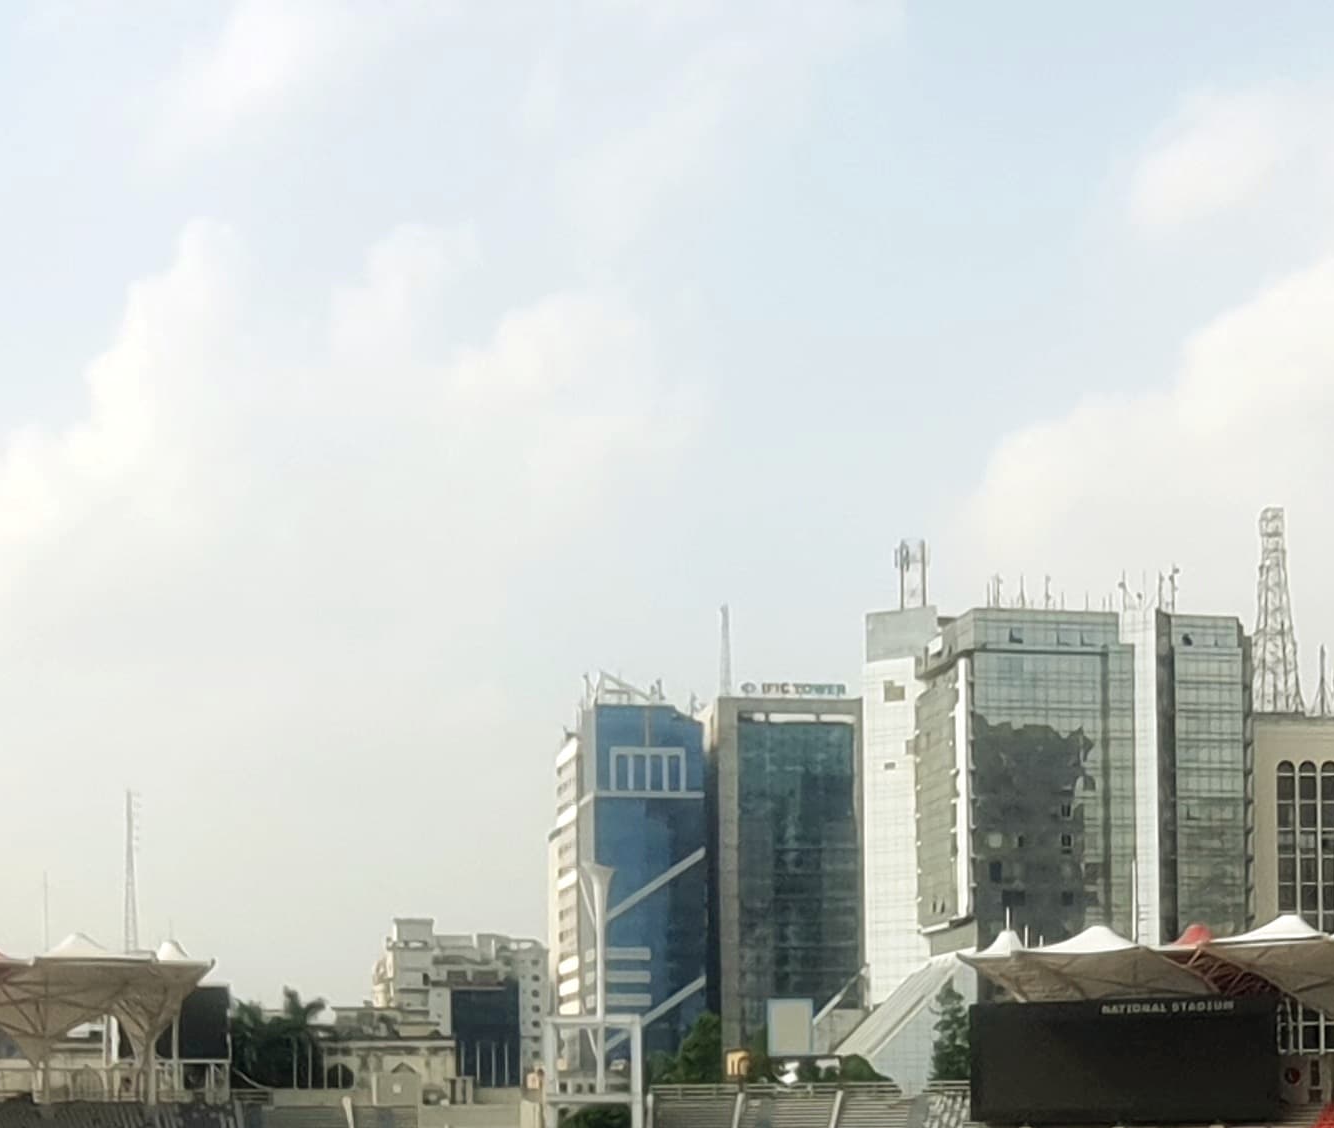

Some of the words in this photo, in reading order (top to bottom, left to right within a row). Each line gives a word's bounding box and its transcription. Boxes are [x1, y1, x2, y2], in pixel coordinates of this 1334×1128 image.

[793, 682, 846, 695] TOWER
[1101, 1002, 1167, 1014] NATIONAL
[1171, 1000, 1235, 1013] STADIUM
